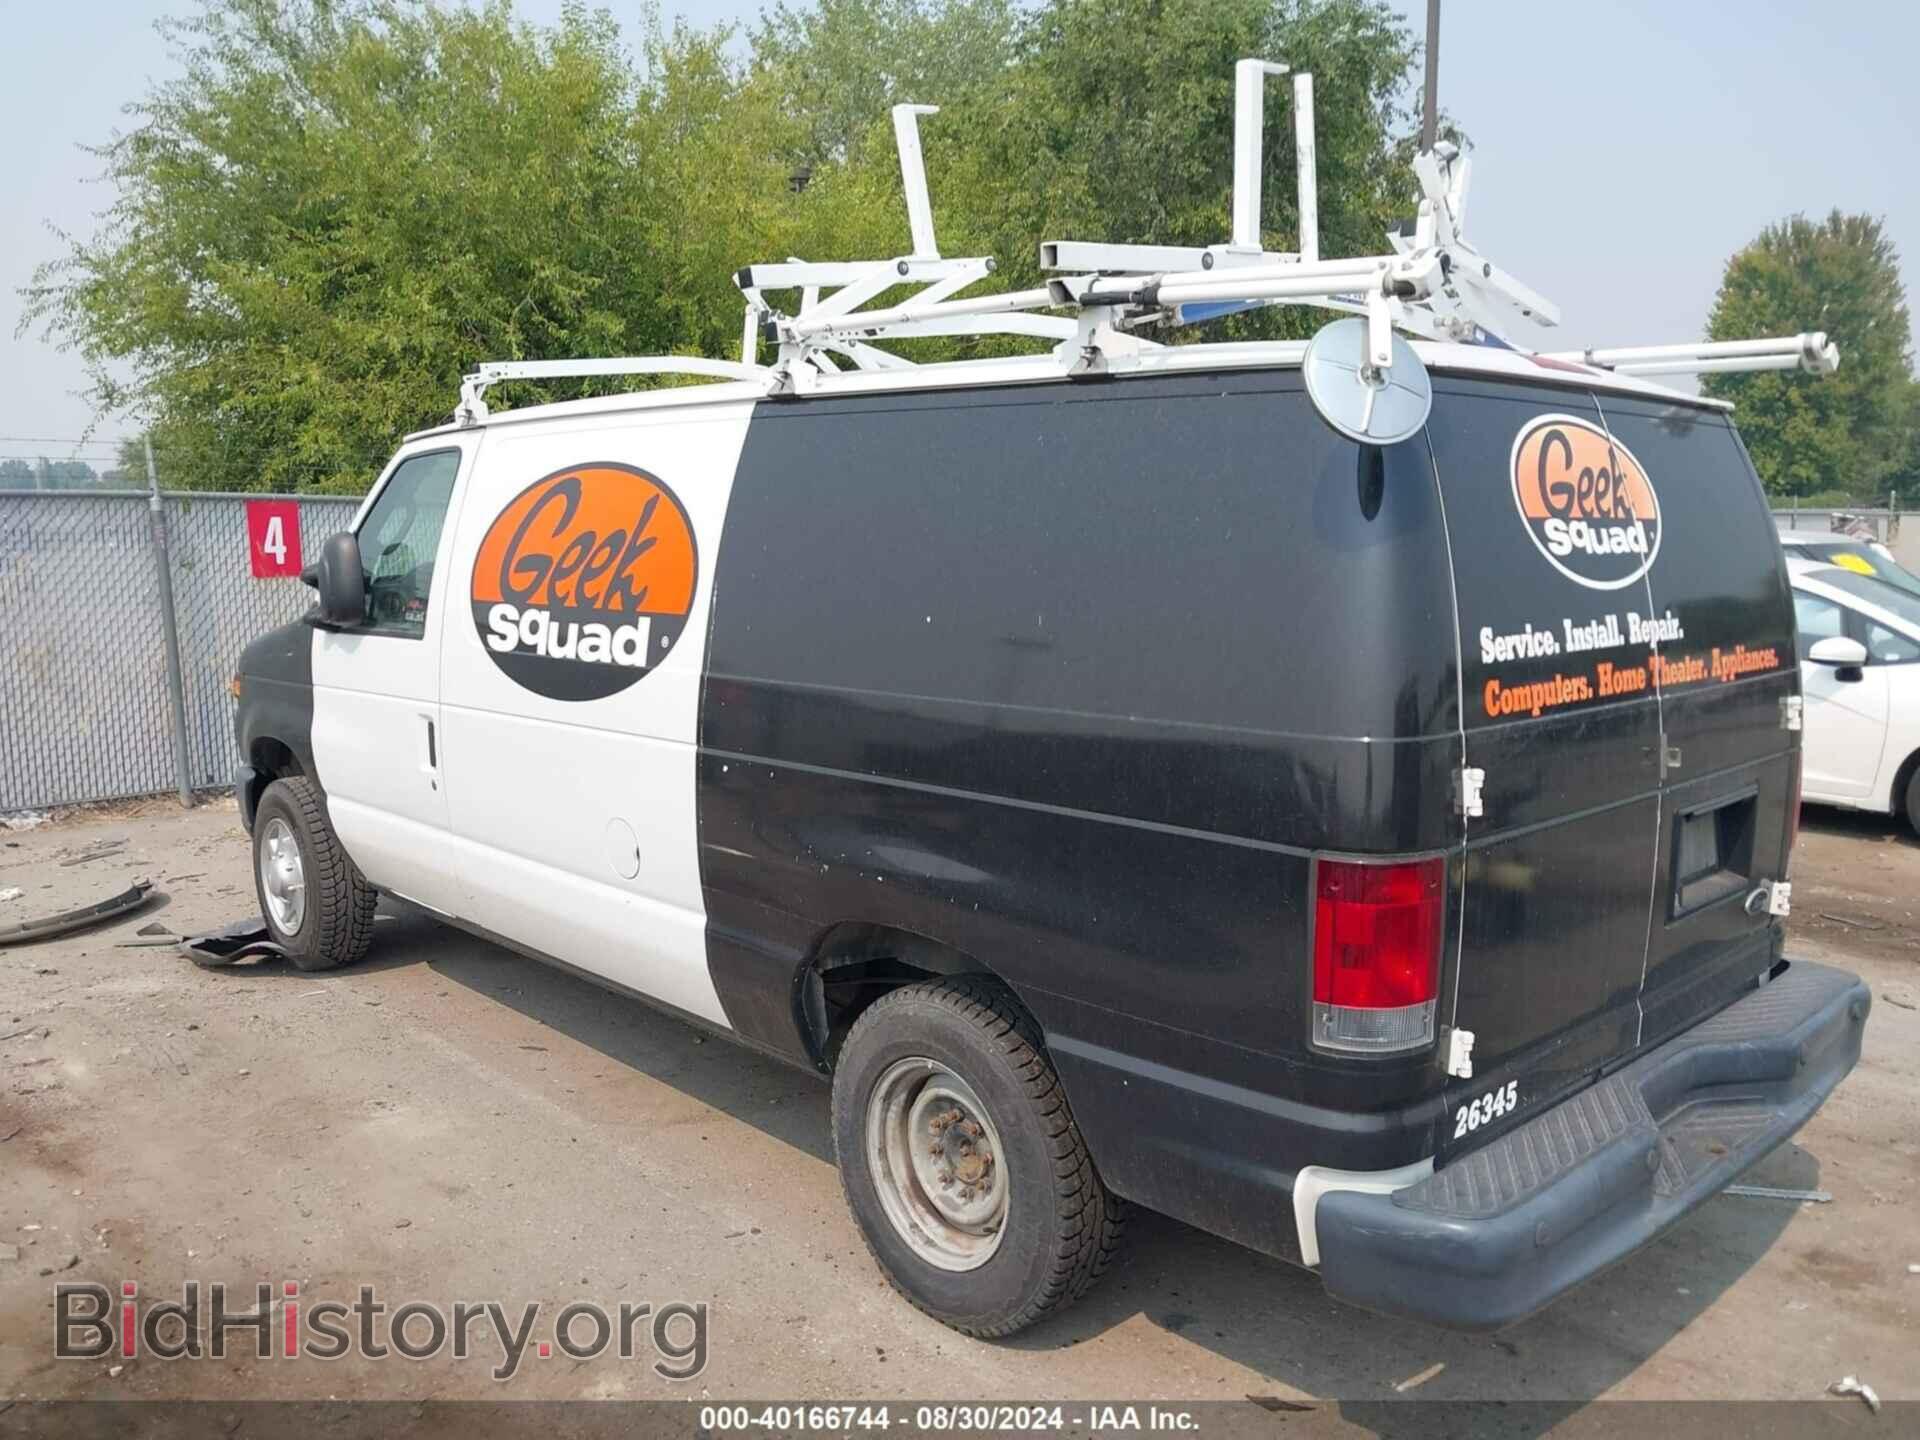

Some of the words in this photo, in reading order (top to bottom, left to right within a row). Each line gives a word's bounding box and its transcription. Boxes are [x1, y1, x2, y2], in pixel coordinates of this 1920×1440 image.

[1538, 429, 1634, 519] Geek
[264, 516, 287, 565] 4
[501, 477, 658, 614] Geek
[1480, 624, 1560, 663] Service.
[1563, 617, 1625, 655] Install.
[1628, 610, 1684, 646] Repair.
[1485, 673, 1593, 717] Computers.
[1598, 661, 1646, 697] Home
[1649, 652, 1708, 688] Theater.
[1711, 645, 1779, 682] Appliances.
[1454, 1080, 1518, 1139] 26345
